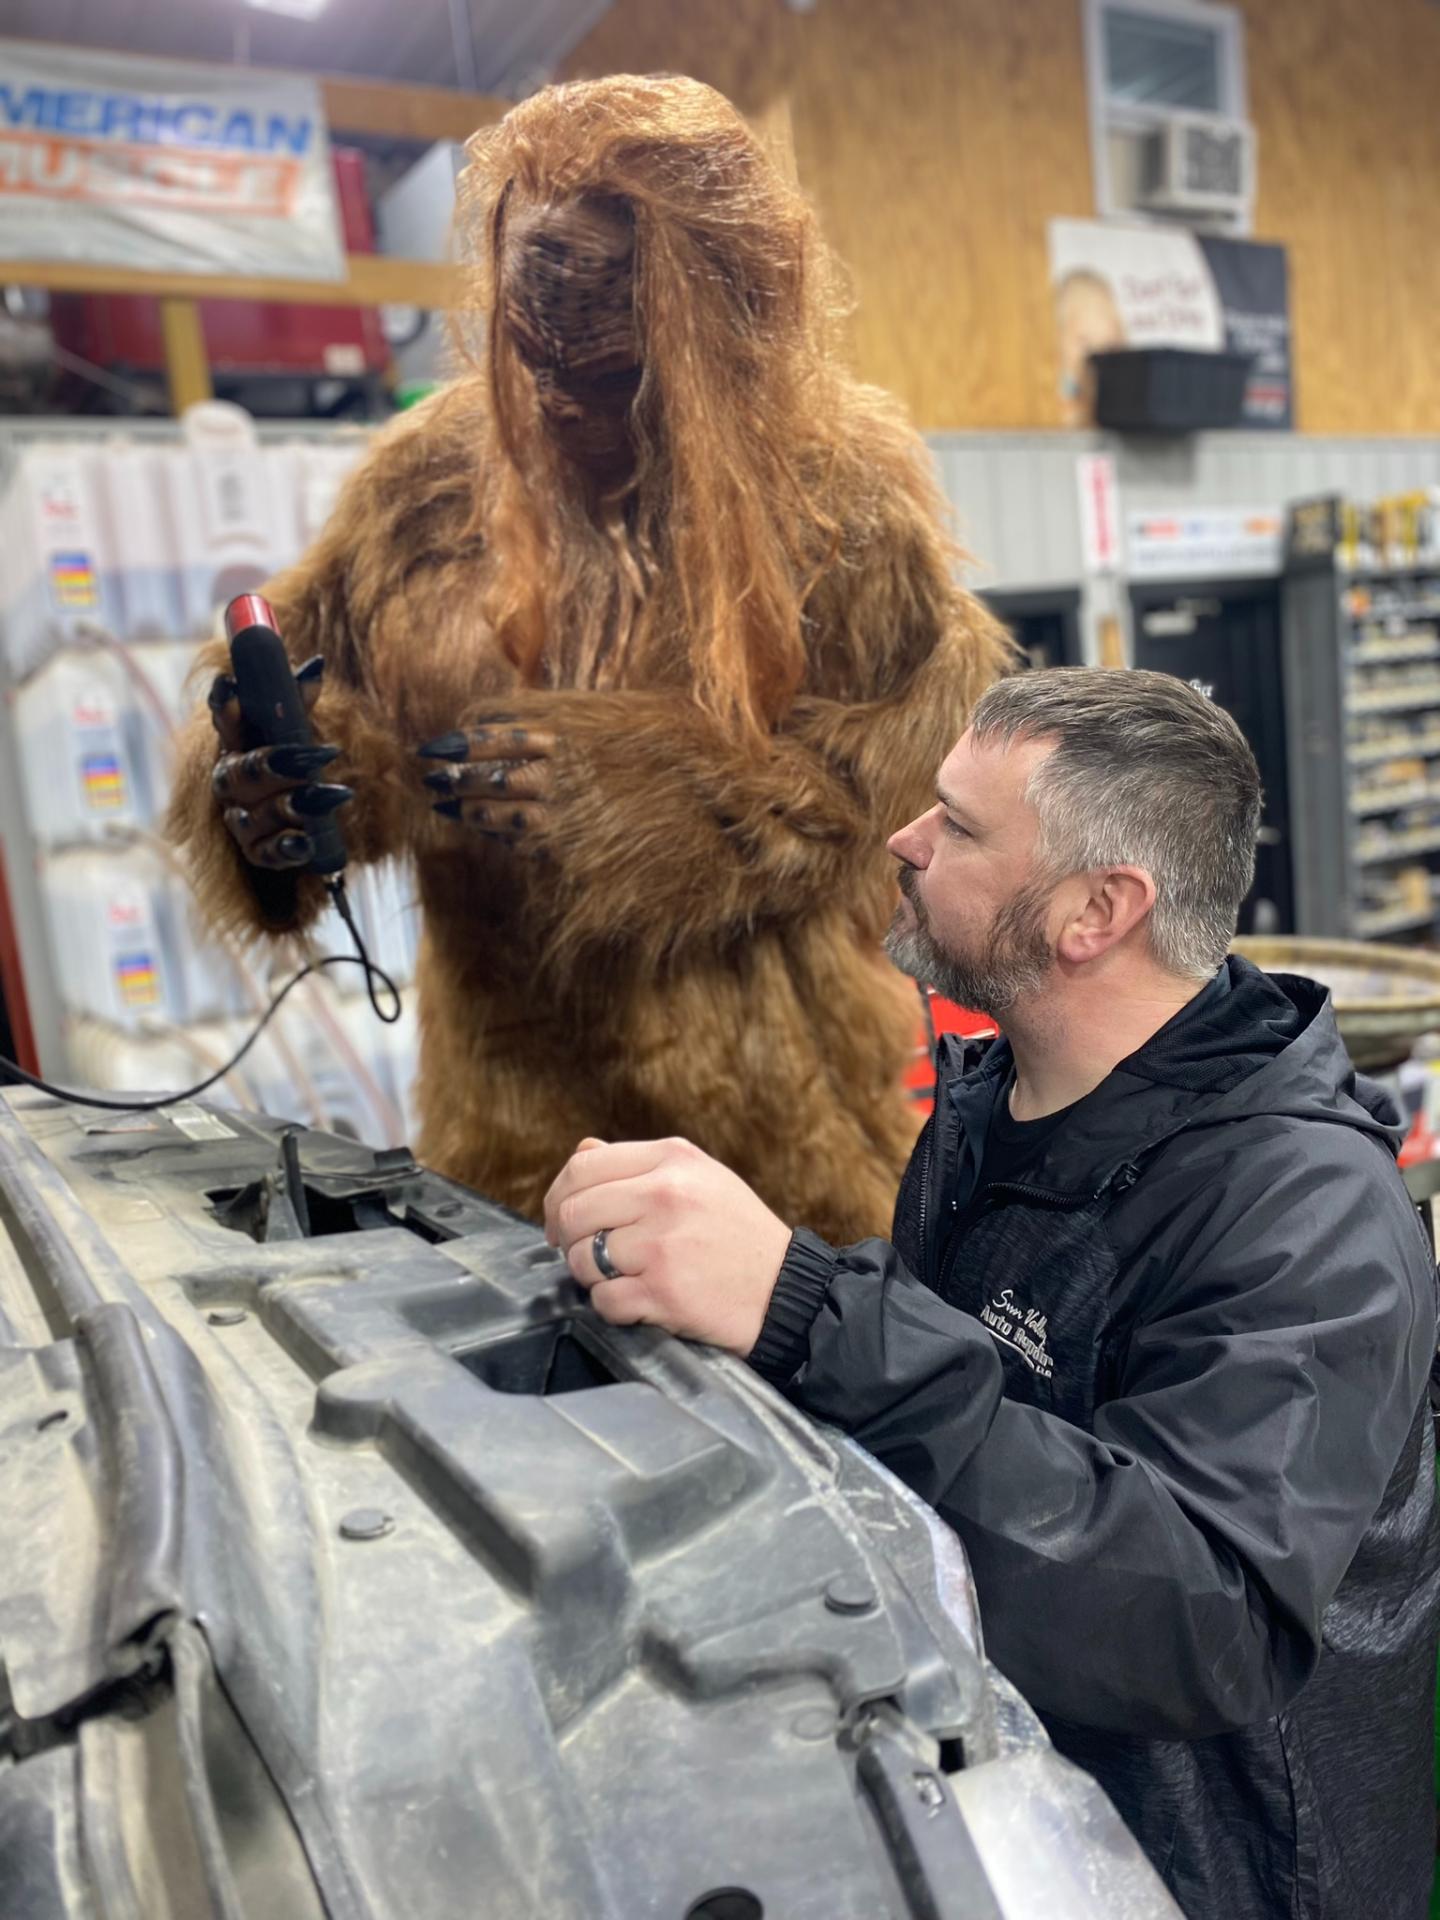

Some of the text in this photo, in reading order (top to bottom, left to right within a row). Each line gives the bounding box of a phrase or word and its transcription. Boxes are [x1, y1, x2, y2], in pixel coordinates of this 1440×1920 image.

[980, 1304, 1013, 1336] Auto
[992, 1289, 1047, 1348] Sun Valley
